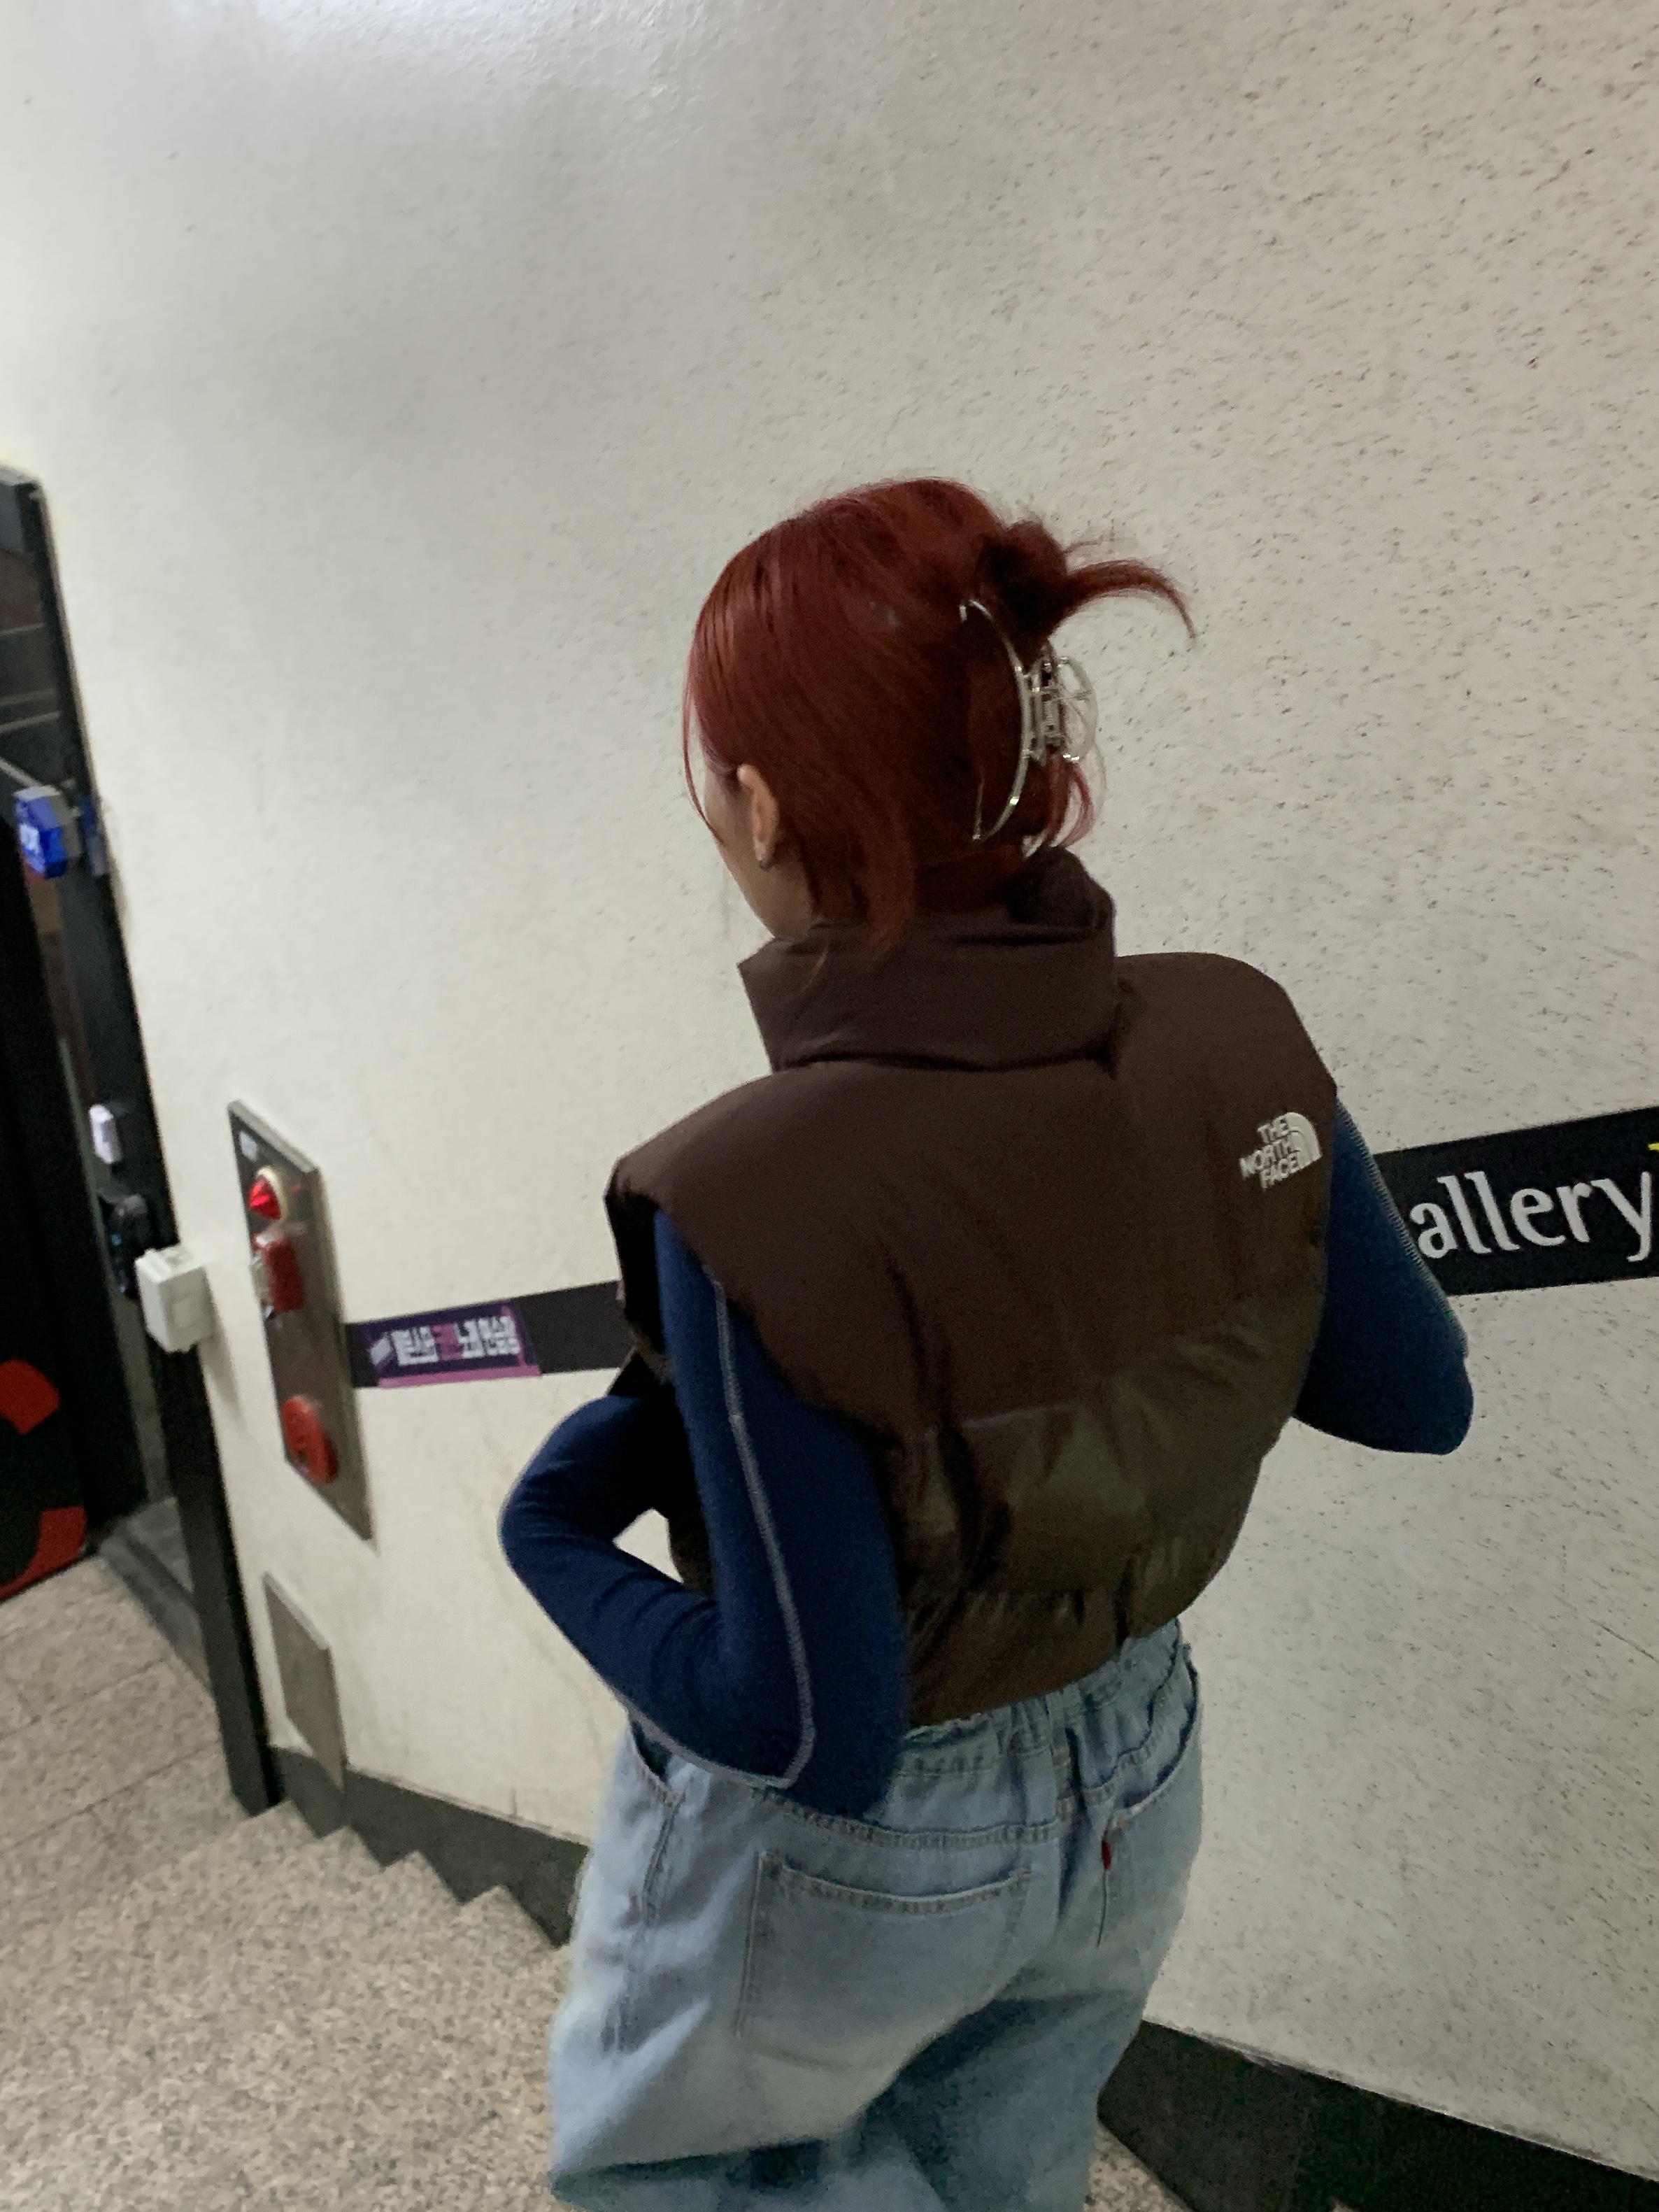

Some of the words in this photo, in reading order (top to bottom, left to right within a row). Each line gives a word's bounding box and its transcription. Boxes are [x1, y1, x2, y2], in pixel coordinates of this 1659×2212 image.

[1258, 1117, 1288, 1144] THE
[1260, 1153, 1298, 1189] FACE
[1409, 1170, 1652, 1263] allery
